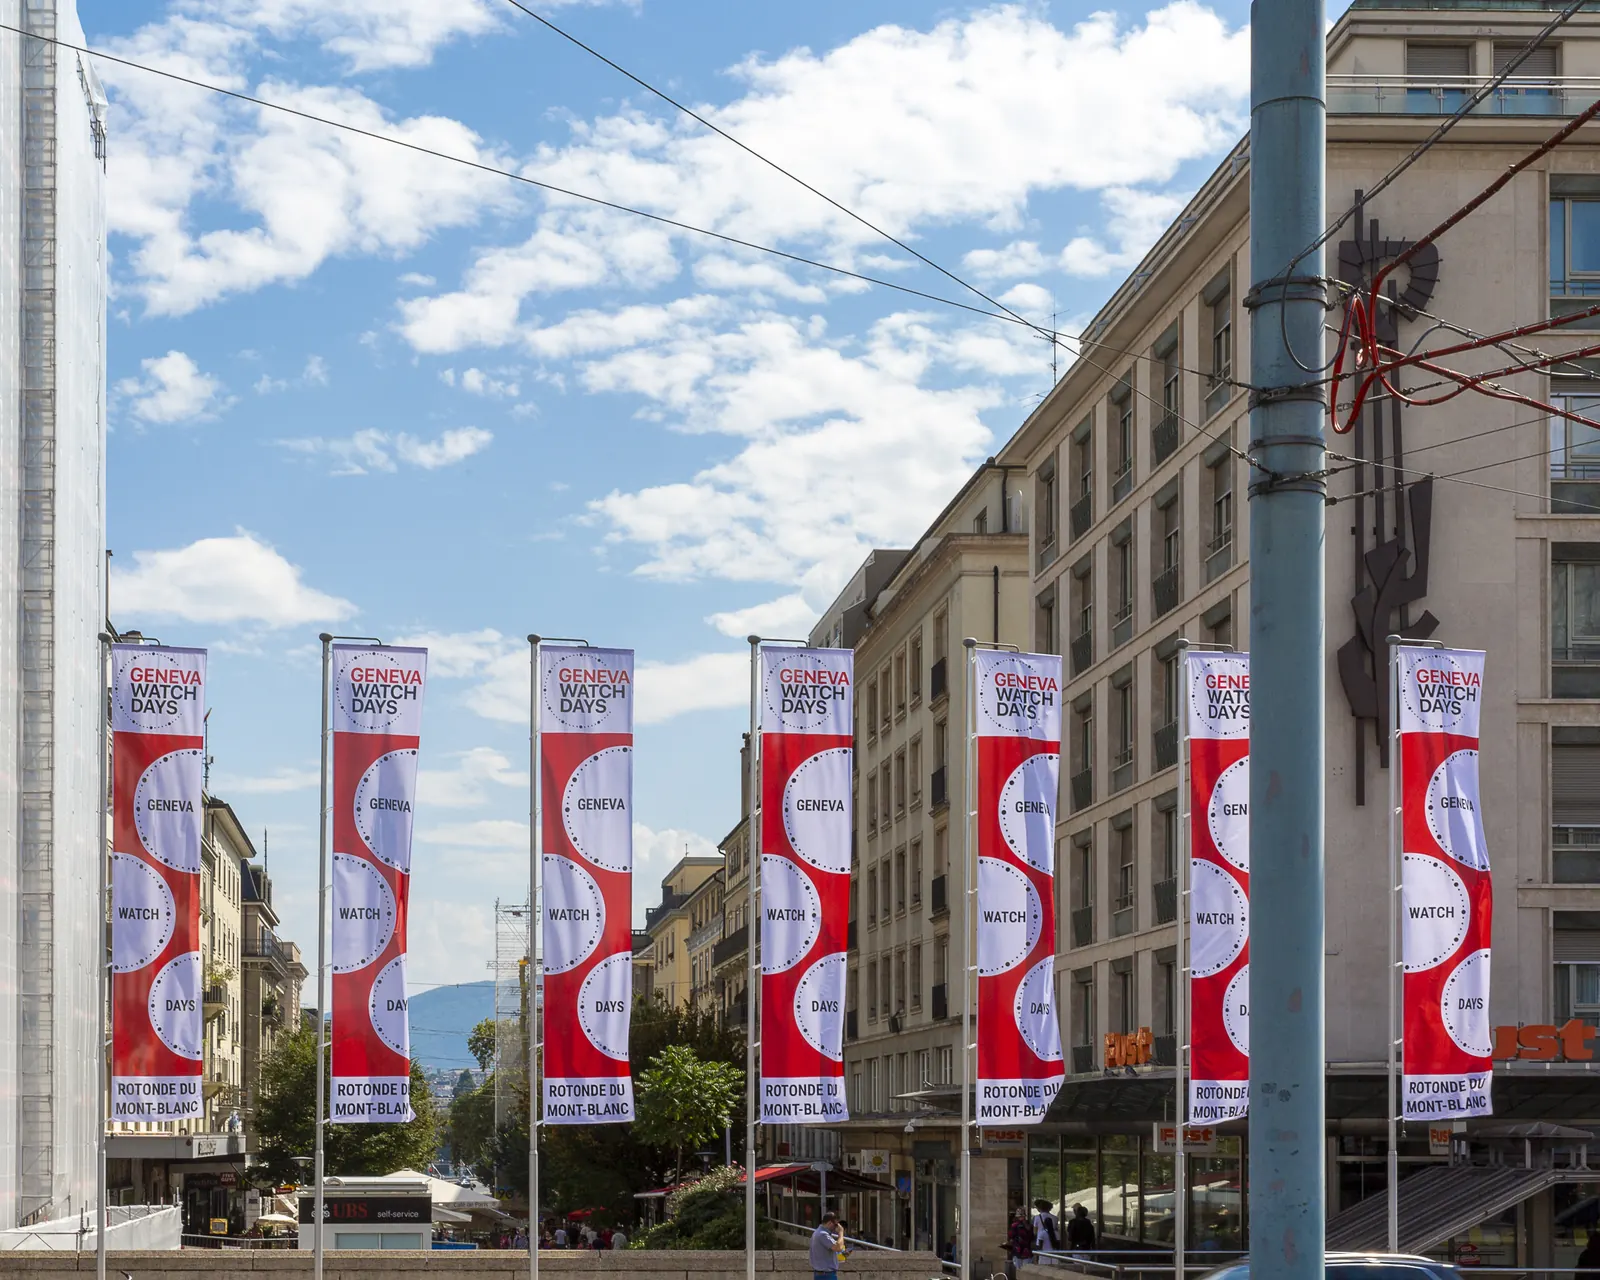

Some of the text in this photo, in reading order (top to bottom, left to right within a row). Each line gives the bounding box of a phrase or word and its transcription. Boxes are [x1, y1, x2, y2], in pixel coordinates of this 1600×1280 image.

[130, 667, 202, 685] GENEVA
[351, 667, 422, 685] GENEVA
[558, 667, 630, 685] GENEVA
[779, 668, 850, 686] GENEVA
[994, 672, 1058, 692] GENEVA
[1205, 674, 1249, 689] GENE
[1416, 668, 1480, 687] GENEVA
[130, 683, 197, 700] WATCH
[351, 683, 417, 700] WATCH
[559, 683, 625, 699] WATCH
[780, 683, 845, 701] WATCH
[995, 687, 1054, 706] WATCH
[1417, 684, 1476, 702] WATCH
[131, 699, 178, 715] DAYS
[351, 699, 398, 715] DAYS
[560, 698, 607, 713] DAYS
[781, 699, 827, 715] DAYS
[996, 702, 1037, 720] DAYS
[1208, 704, 1249, 719] DAYS
[1419, 699, 1462, 715] DAYS
[147, 799, 194, 813] GENEVA
[369, 798, 411, 813] GENEVA
[577, 798, 625, 811] GENEVA
[796, 799, 844, 812] GENEVA
[1223, 804, 1247, 816] GEN
[1440, 796, 1474, 812] GENEVA
[118, 907, 160, 920] WATCH
[339, 907, 380, 920] WATCH
[549, 908, 590, 921] WATCH
[767, 909, 805, 921] WATCH
[983, 911, 1026, 923] WATCH
[1196, 912, 1234, 925] WATCH
[1409, 906, 1454, 919] WATCH
[165, 1000, 195, 1012] DAYS
[595, 1001, 624, 1013] DAYS
[811, 1000, 838, 1013] DAYS
[1030, 1002, 1050, 1015] DAYS
[1239, 1004, 1249, 1016] D
[1458, 998, 1483, 1010] DAYS
[117, 1082, 196, 1096] ROTONDE DU
[337, 1083, 410, 1096] ROTONDE D
[549, 1083, 625, 1097] ROTONDE DU
[765, 1084, 823, 1097] ROTONDE
[983, 1082, 1059, 1099] ROTONDE DU
[1196, 1086, 1246, 1100] ROTONDE
[1409, 1078, 1486, 1094] ROTONDE DU
[115, 1100, 198, 1115] MONT-BLANC
[547, 1102, 629, 1117] MONT-BLANC
[763, 1102, 843, 1116] MONT-BLANC
[981, 1103, 1051, 1118] MONT-BLA
[1406, 1096, 1487, 1113] MONT-BLANC
[333, 1203, 419, 1218] UBS self-service
